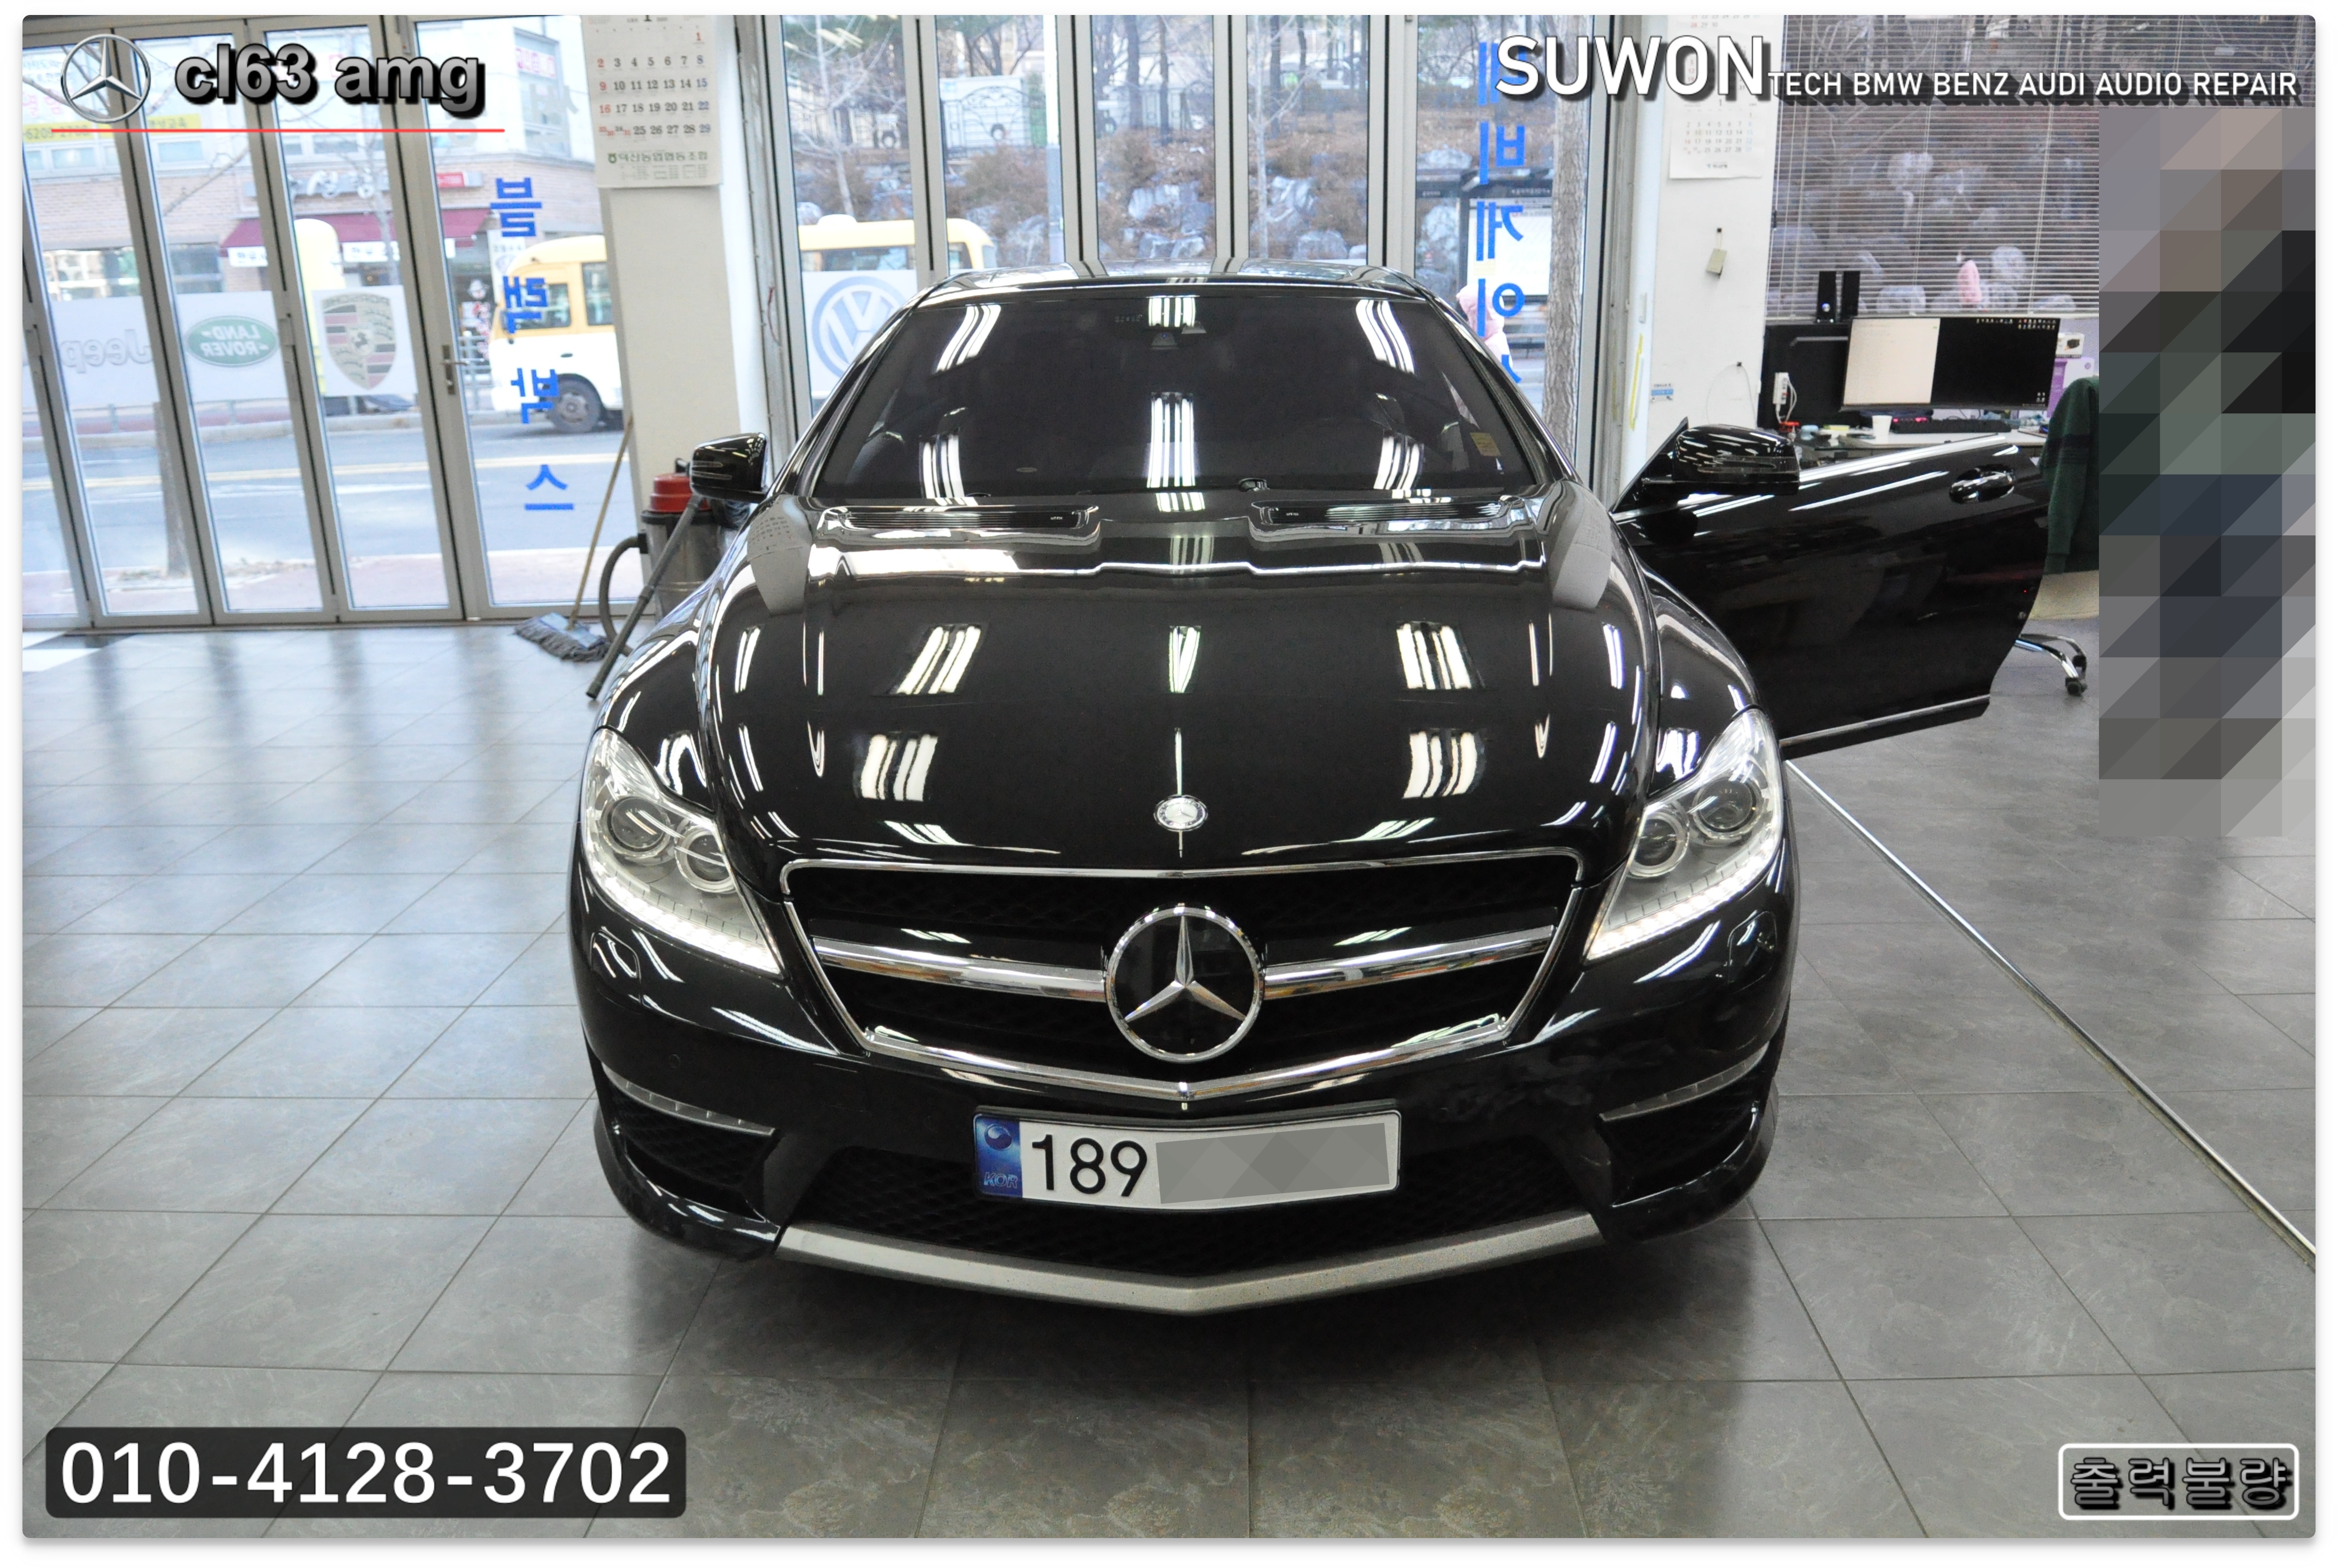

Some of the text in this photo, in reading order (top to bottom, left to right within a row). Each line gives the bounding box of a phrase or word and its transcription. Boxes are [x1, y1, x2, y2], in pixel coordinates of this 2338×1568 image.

[696, 32, 702, 41] 1
[597, 55, 704, 67] 2 3 4 5 6 7 8
[599, 78, 708, 90] 9 10 11 12 13 14 15
[599, 101, 710, 113] 16 17 18 19 20 21 22
[633, 124, 711, 135] 25 26 27 28 29
[1032, 1134, 1148, 1197] 189
[984, 1172, 1018, 1188] KOR
